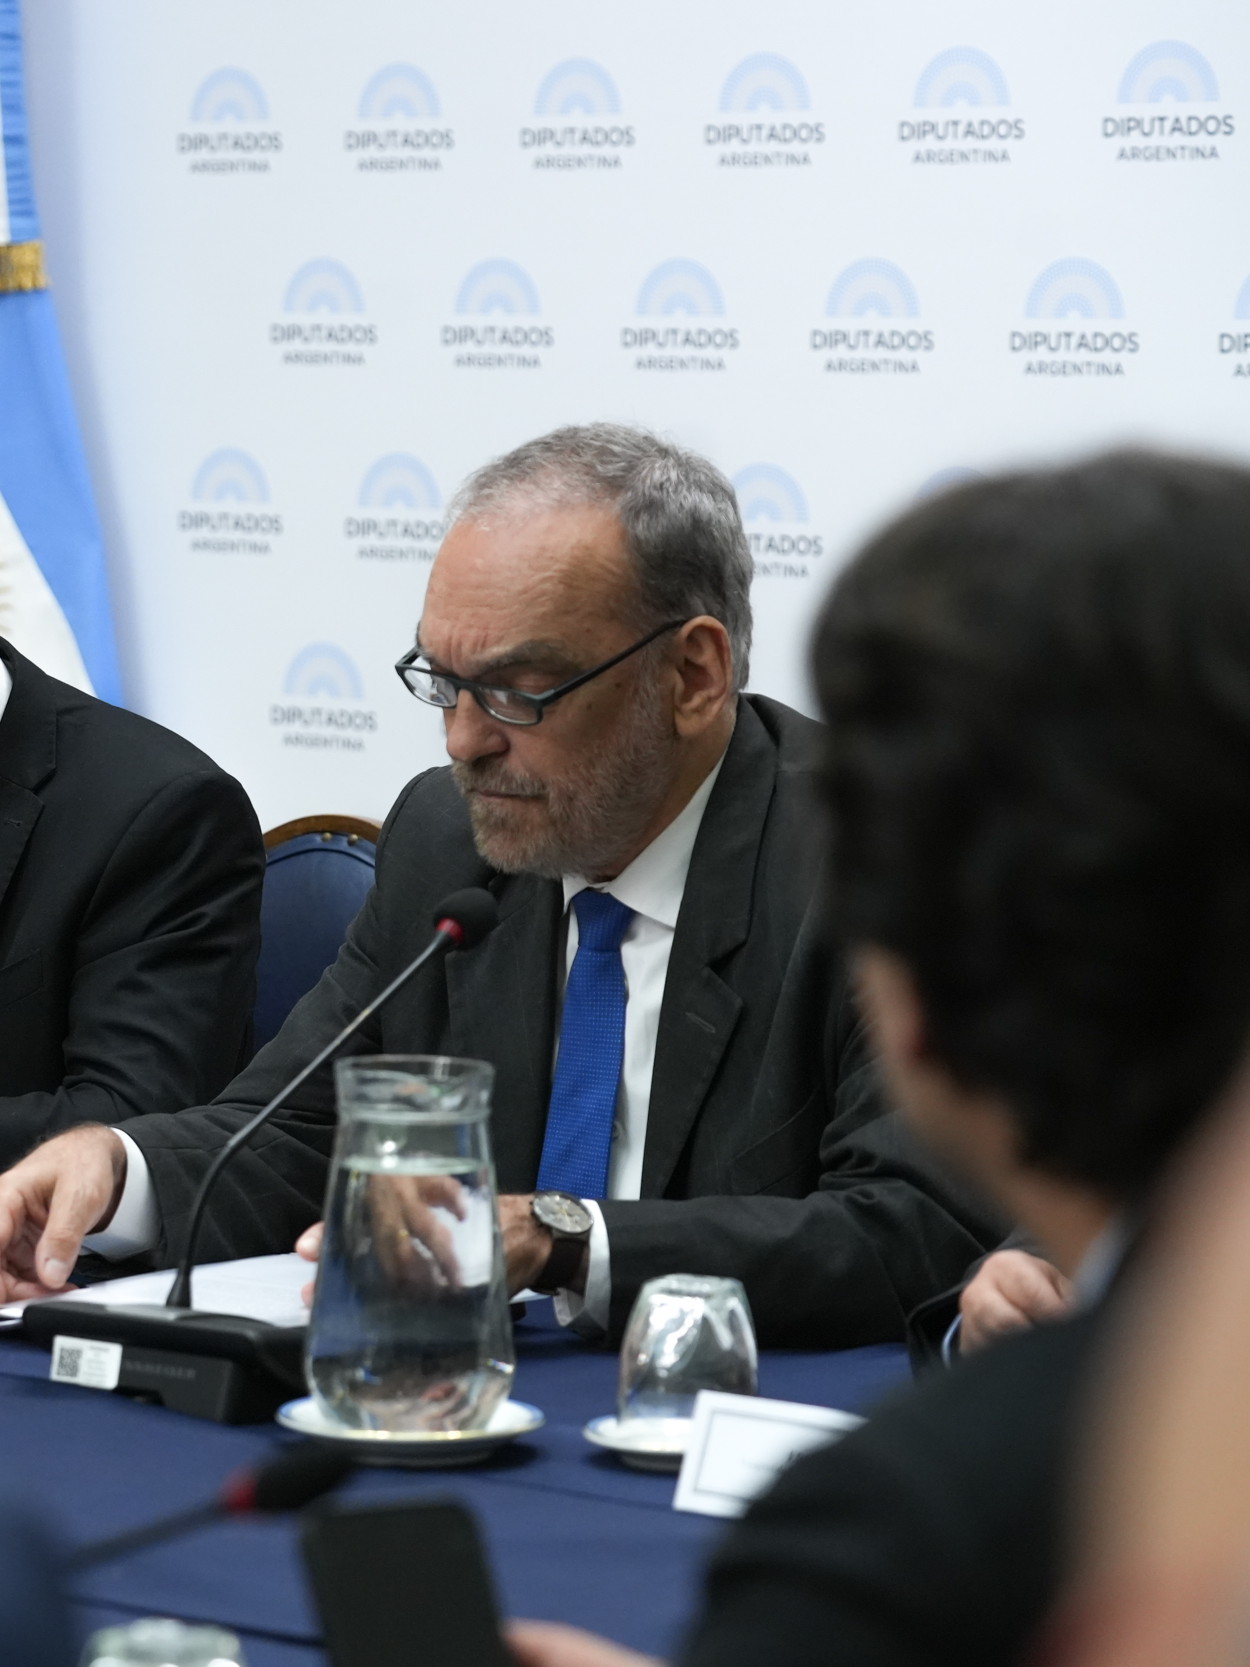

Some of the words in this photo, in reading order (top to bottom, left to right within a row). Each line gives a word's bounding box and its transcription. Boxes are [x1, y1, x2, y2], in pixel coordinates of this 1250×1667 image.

[519, 125, 636, 149] DIPUTADOS
[703, 121, 826, 147] DIPUTADOS
[897, 117, 1026, 143] DIPUTADOS
[1101, 113, 1236, 139] DIPUTADOS
[177, 131, 284, 154] DIPUTADOS
[344, 128, 455, 152] DIPUTADOS
[356, 156, 442, 173] ARGENTINA
[532, 153, 622, 170] ARGENTINA
[717, 151, 812, 168] ARGENTINA
[912, 147, 1011, 165] ARGENTINA
[1116, 144, 1220, 162] ARGENTINA
[189, 158, 271, 175] ARGENTINA
[269, 323, 378, 346] DIPUTADOS
[440, 324, 555, 348] DIPUTADOS
[620, 327, 740, 351] DIPUTADOS
[810, 328, 935, 353] DIPUTADOS
[1009, 330, 1140, 355] DIPUTADOS
[282, 350, 366, 366] ARGENTINA
[453, 352, 542, 369] ARGENTINA
[634, 355, 726, 372] ARGENTINA
[824, 357, 920, 375] ARGENTINA
[1023, 360, 1125, 377] ARGENTINA
[178, 510, 284, 536] DIPUTADOS
[344, 517, 446, 540] DIPUTADO
[190, 538, 272, 556] ARGENTINA
[357, 545, 437, 561] ARGENTIN
[748, 533, 824, 557] TADOS
[269, 704, 378, 733] DIPUTADOS
[282, 732, 366, 752] ARGENTINA
